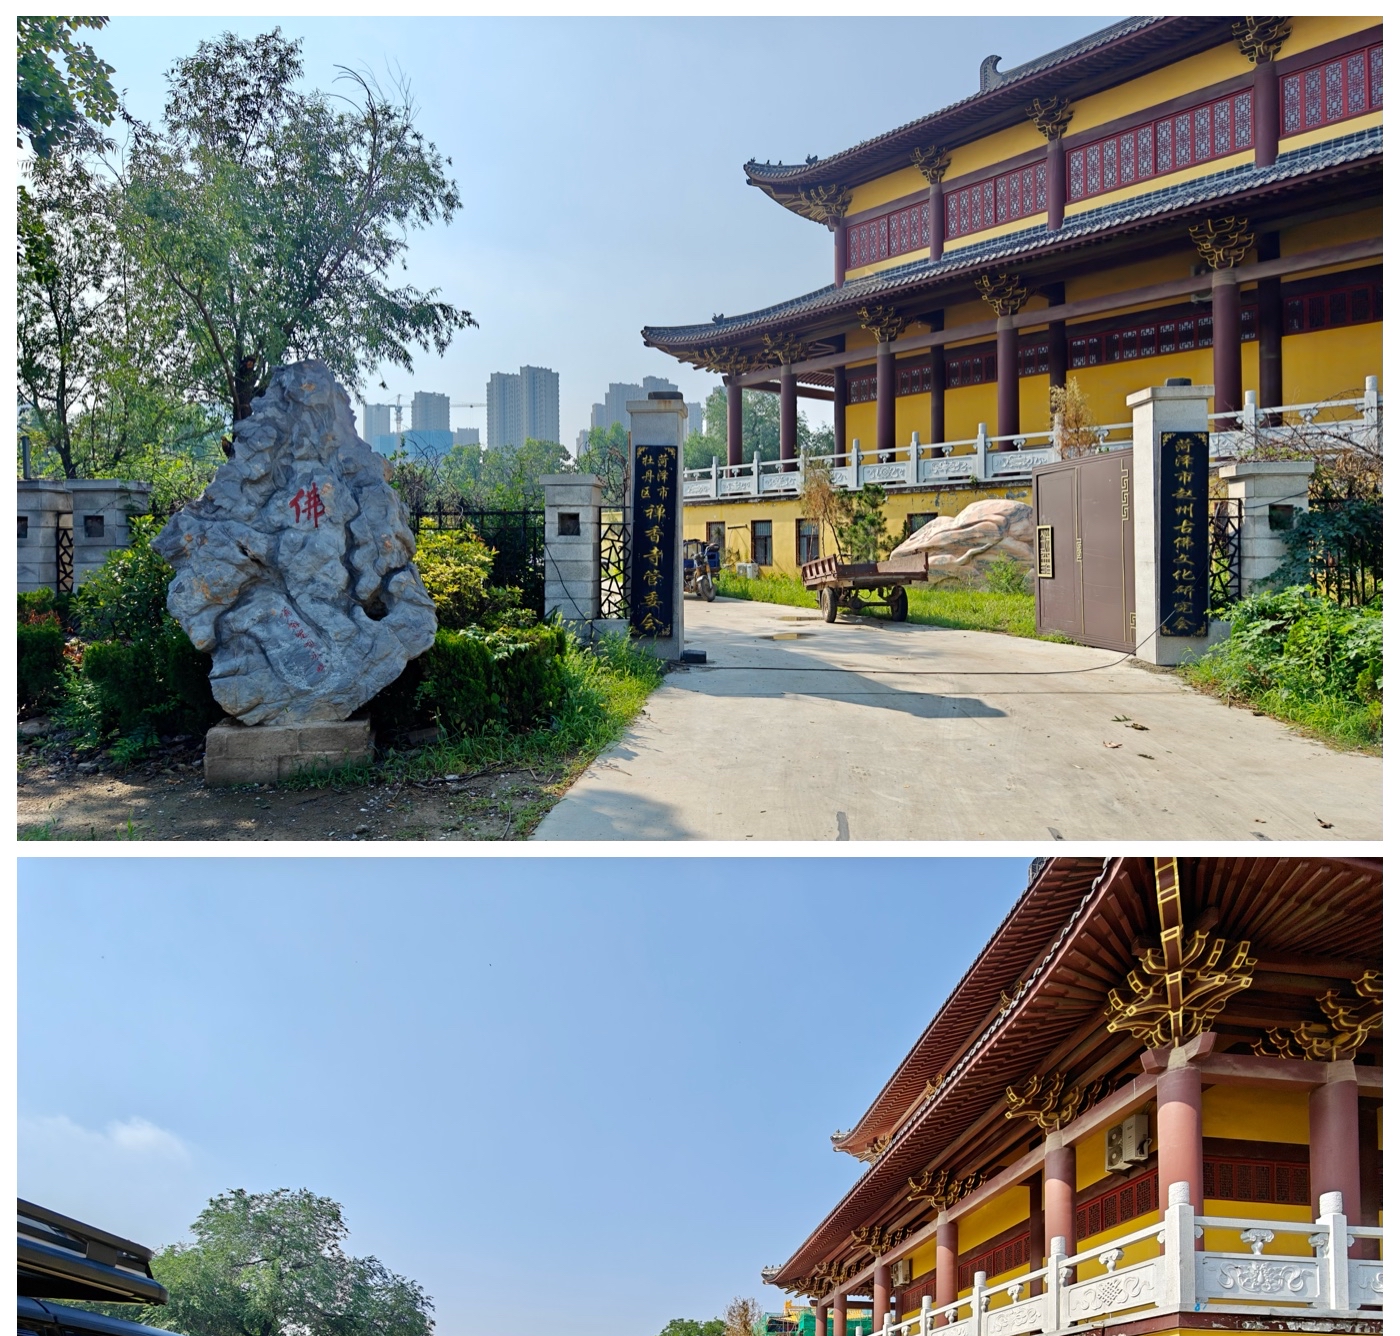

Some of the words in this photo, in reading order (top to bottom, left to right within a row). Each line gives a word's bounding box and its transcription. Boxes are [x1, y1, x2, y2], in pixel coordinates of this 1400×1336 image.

[641, 455, 655, 499] 牡丹区
[657, 453, 669, 500] 菏泽市
[289, 482, 325, 528] 佛
[641, 503, 666, 630] 禅香寺管委会
